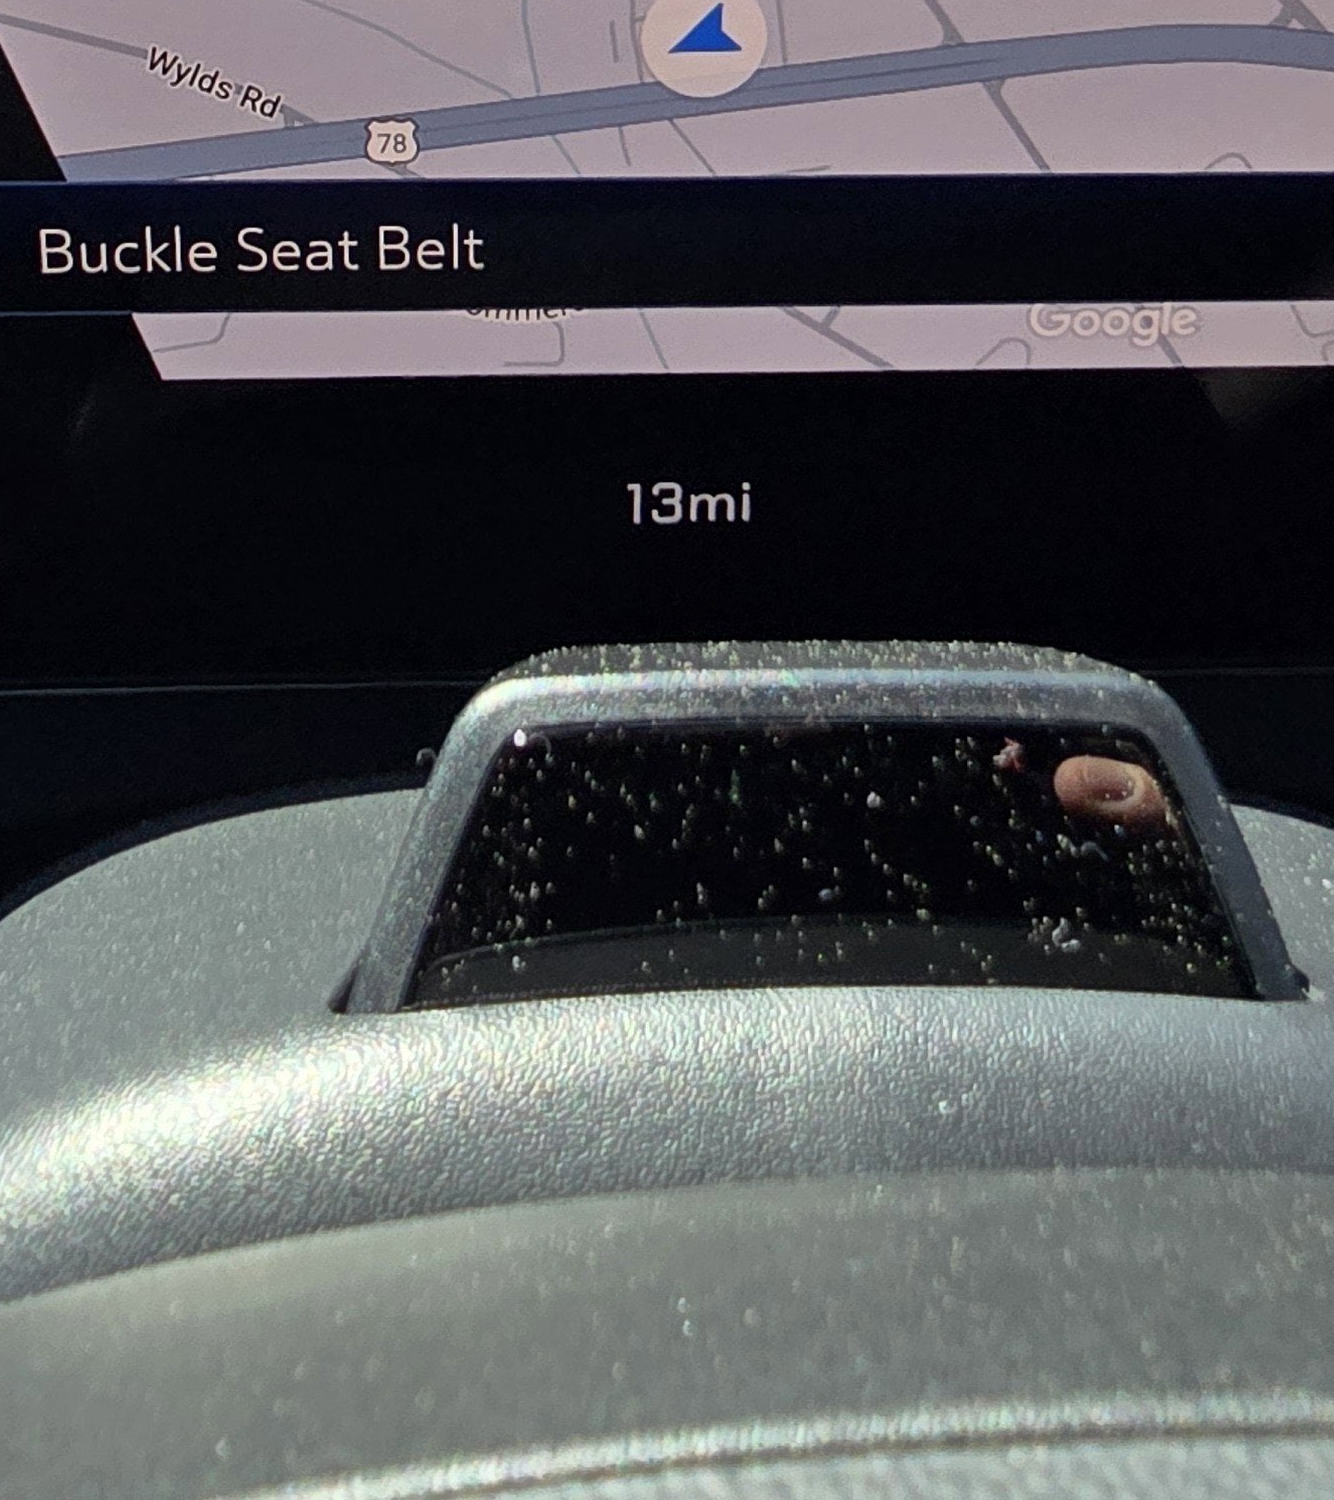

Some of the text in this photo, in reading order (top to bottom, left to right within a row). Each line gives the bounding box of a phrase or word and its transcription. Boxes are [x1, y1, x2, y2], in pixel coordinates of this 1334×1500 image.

[146, 46, 282, 119] Wylds Rd
[377, 133, 407, 154] 78
[39, 222, 485, 274] Buckle Seat Belt
[1029, 302, 1198, 347] Google
[626, 481, 752, 525] 13mi
